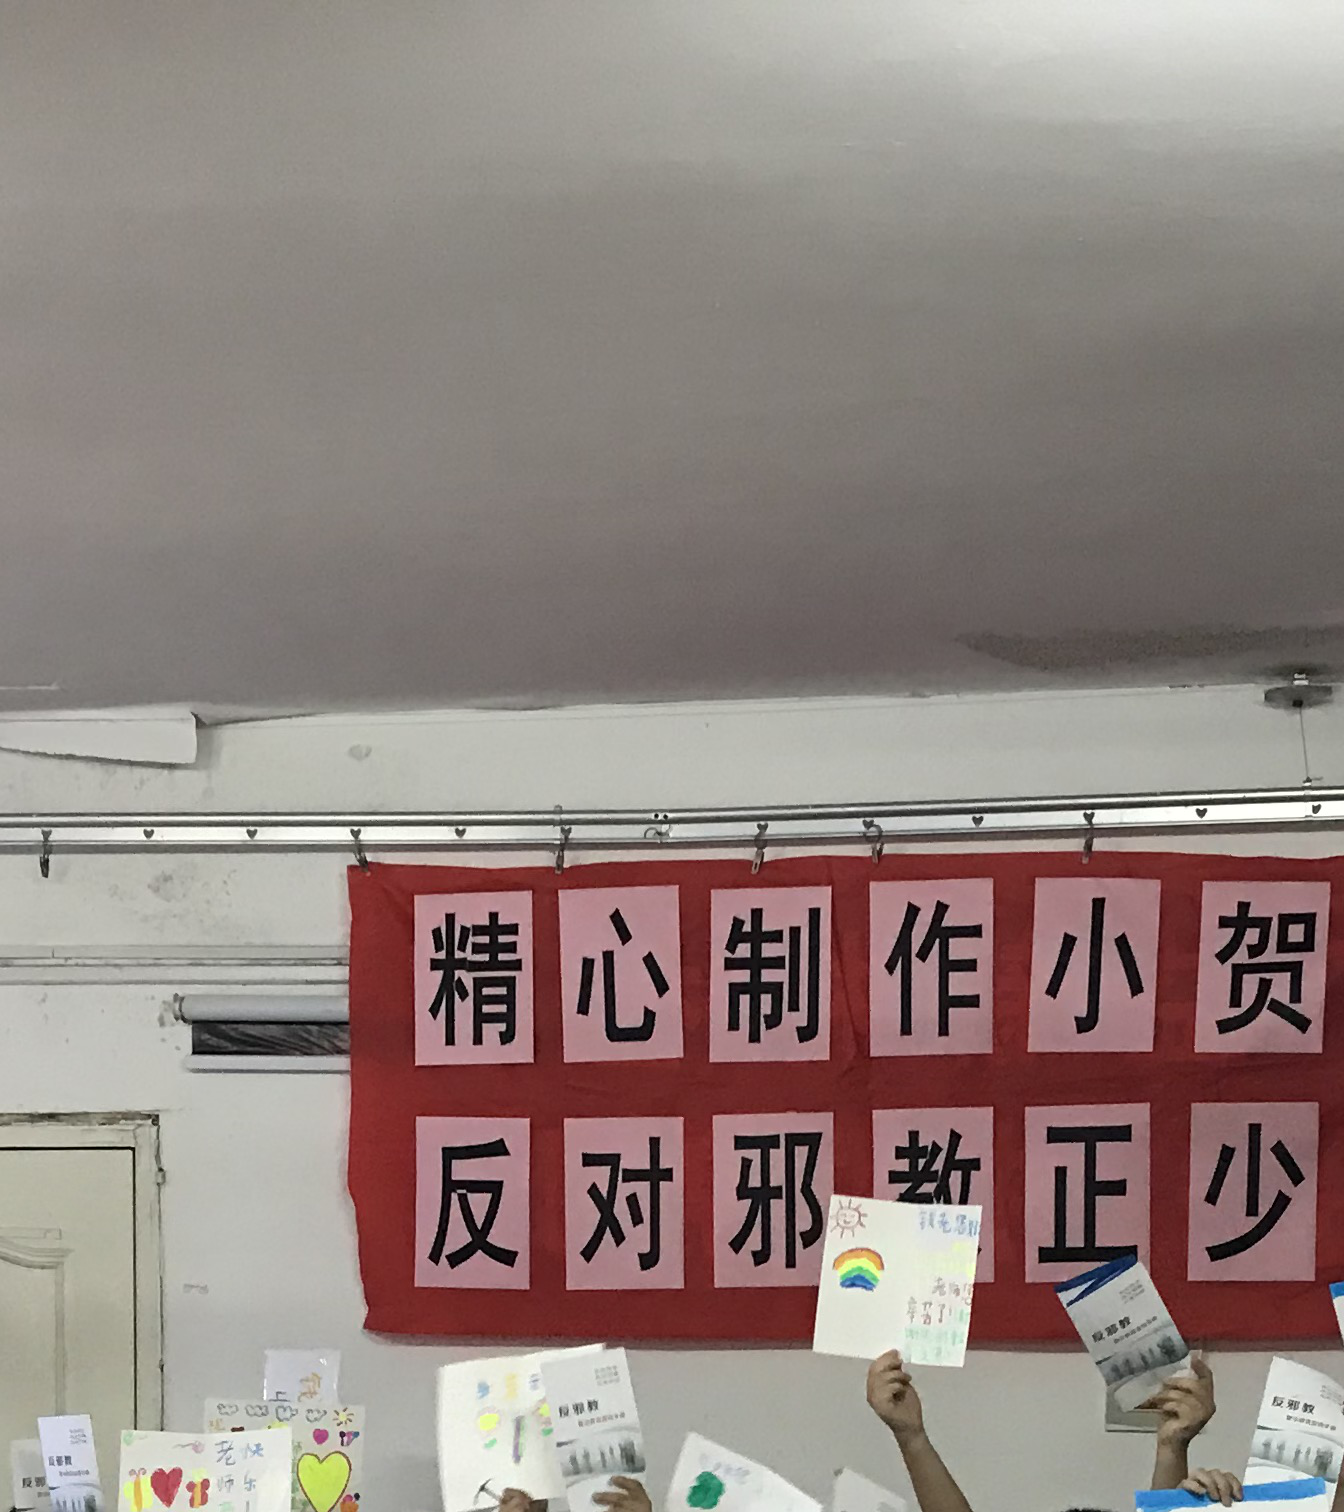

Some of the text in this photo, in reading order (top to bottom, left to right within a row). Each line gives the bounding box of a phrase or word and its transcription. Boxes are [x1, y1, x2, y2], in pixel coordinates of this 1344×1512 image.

[559, 1399, 599, 1418] 反邪教
[1271, 1396, 1316, 1415] 反邪教
[22, 1477, 47, 1488] 反邪
